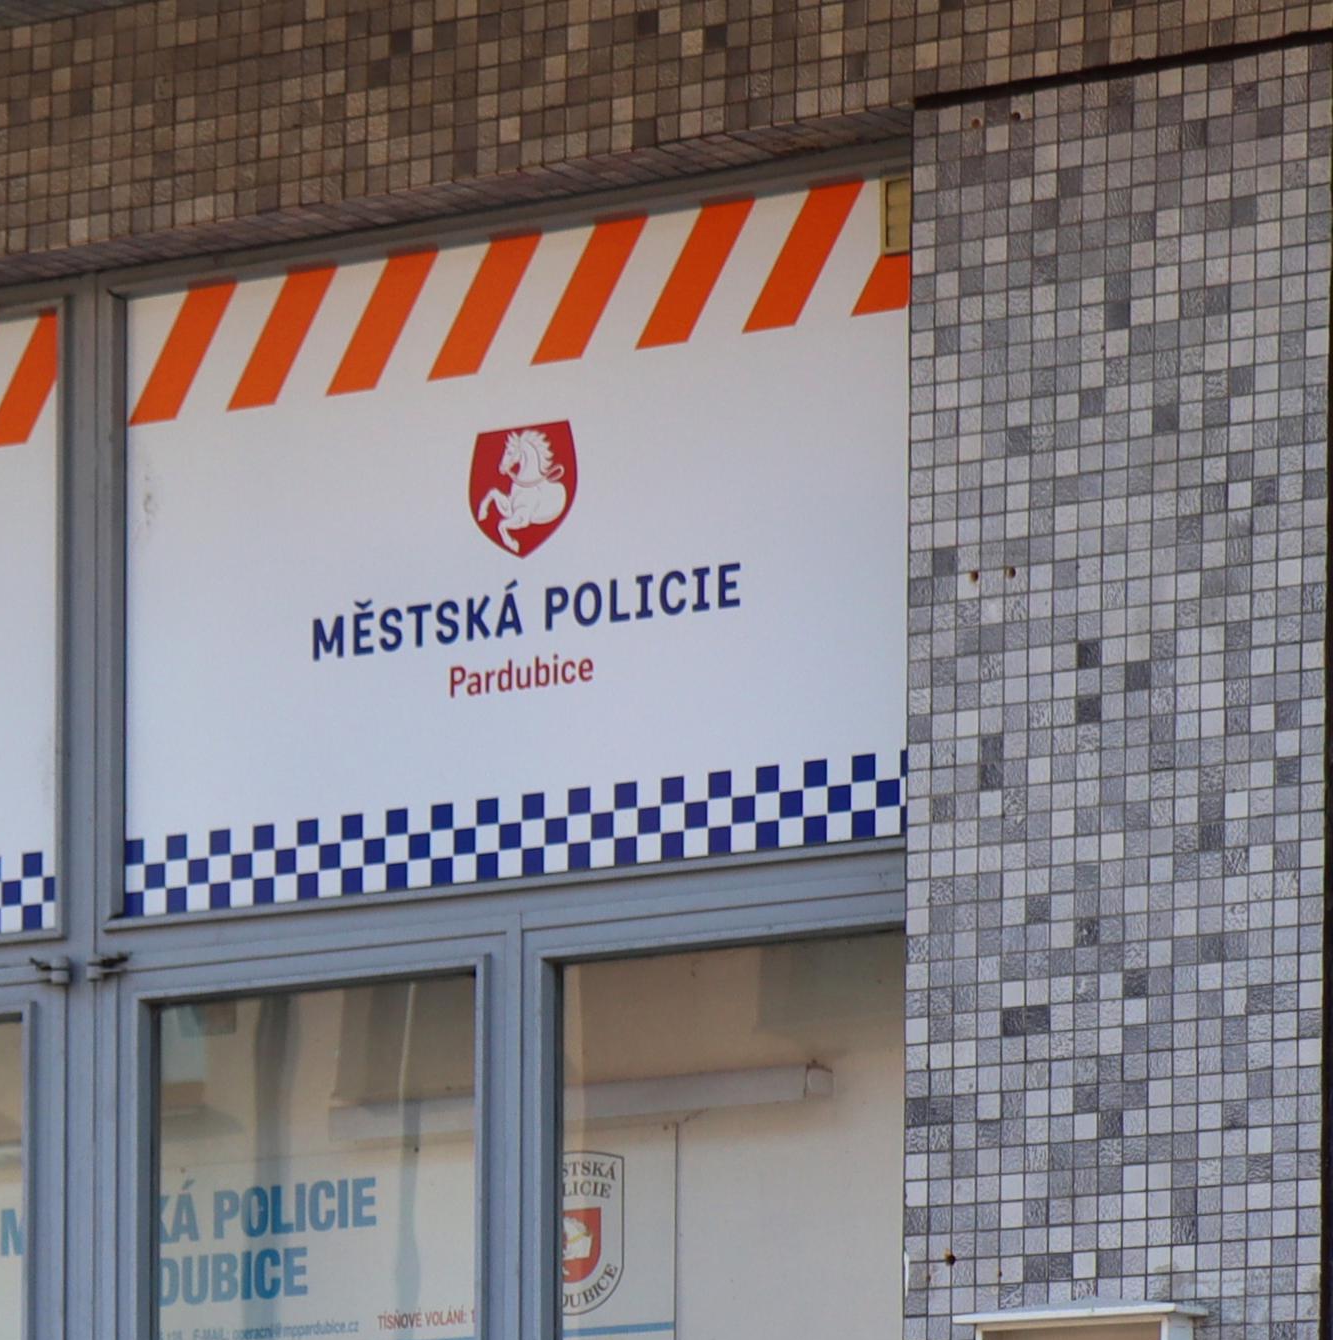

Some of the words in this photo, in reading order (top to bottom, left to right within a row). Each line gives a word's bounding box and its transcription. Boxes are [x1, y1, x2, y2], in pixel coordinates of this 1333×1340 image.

[312, 578, 523, 662] MĚSTSKÁ
[544, 562, 741, 632] POLICIE
[448, 653, 595, 699] Pardubice
[562, 1160, 617, 1181] STSKÁ
[562, 1180, 612, 1199] LICIE
[213, 1177, 377, 1238] POLICIE
[160, 1247, 308, 1307] DUBICE
[562, 1262, 618, 1309] DUBICE
[377, 1307, 423, 1330] TÍSŇOVÉ
